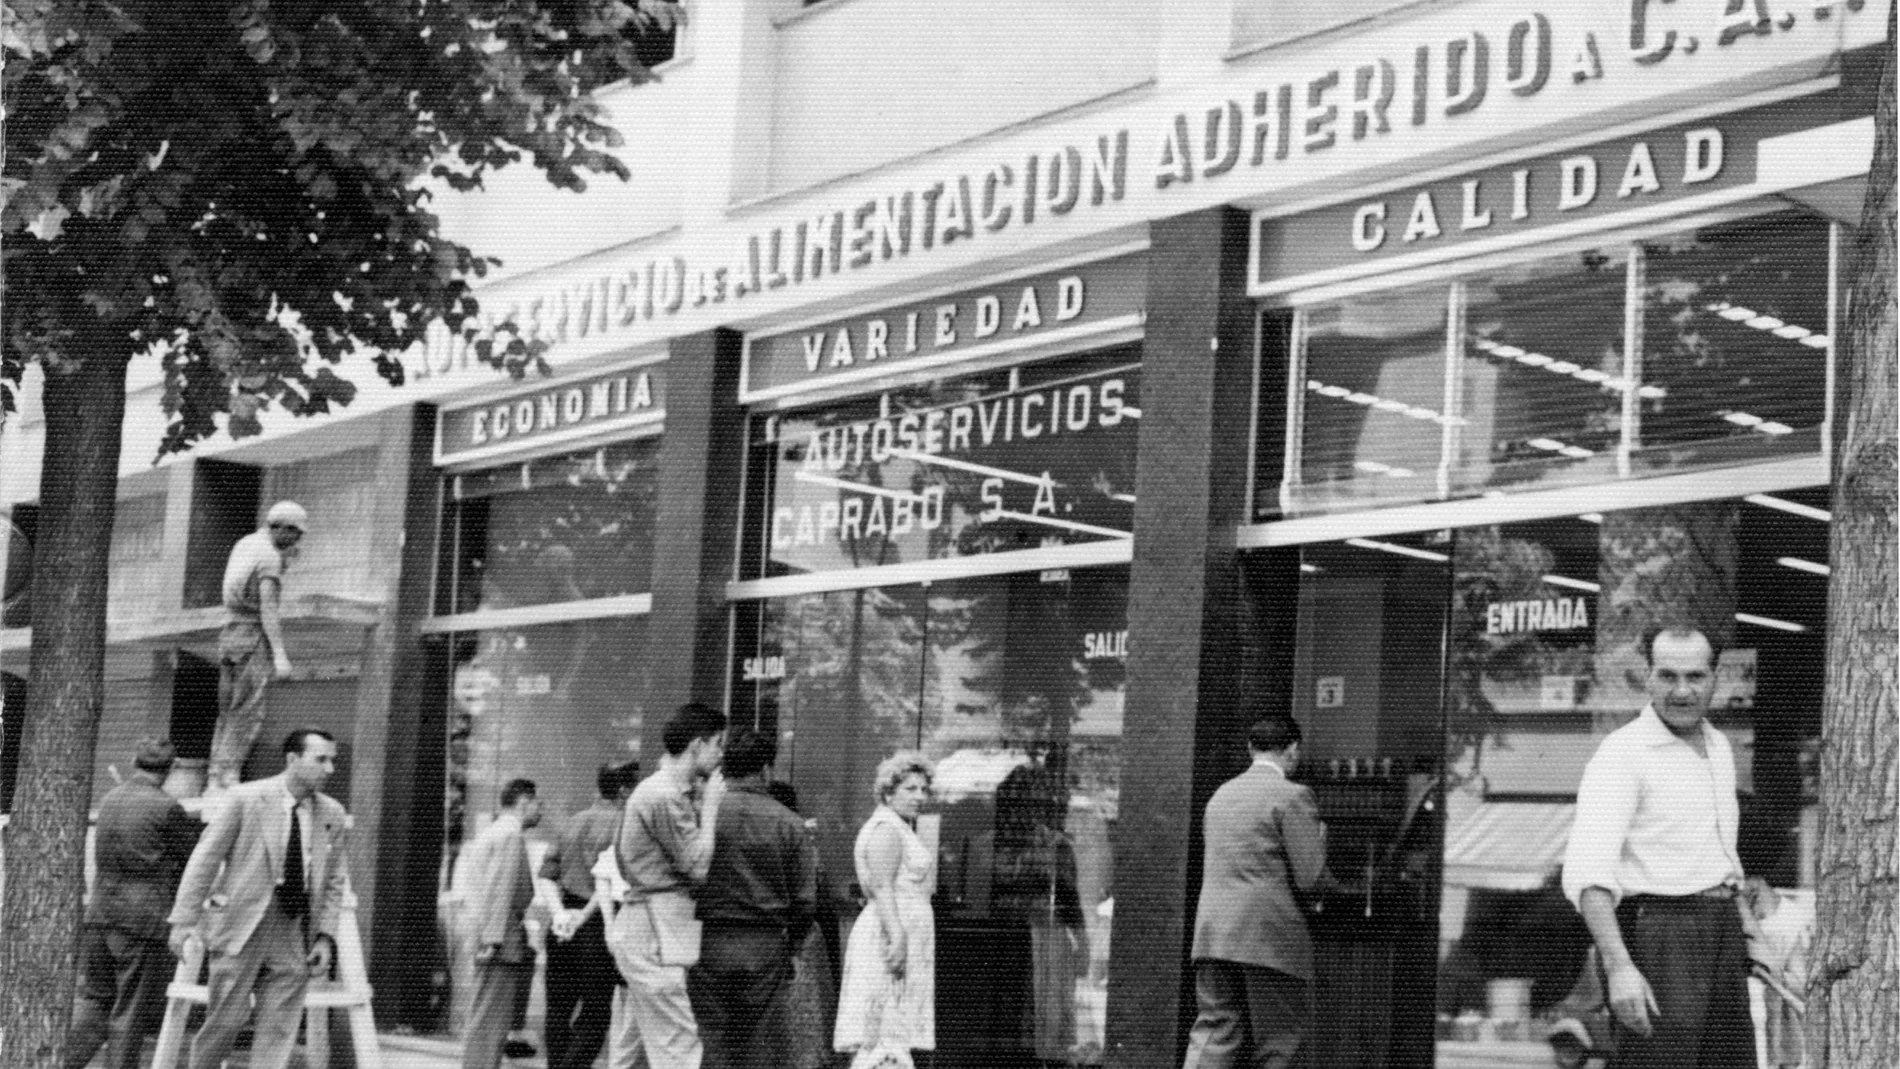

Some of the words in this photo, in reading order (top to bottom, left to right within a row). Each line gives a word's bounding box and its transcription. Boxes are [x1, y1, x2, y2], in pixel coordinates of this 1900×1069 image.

[734, 127, 1129, 298] ALIMENTACION
[1153, 9, 1551, 189] ADHERIDO
[1569, 28, 1603, 84] A
[1350, 127, 1726, 253] CALIDAD
[802, 275, 1086, 373] VARIEDAD
[471, 372, 653, 445] ECONOMIA
[803, 379, 1126, 473] AUTOSERVICIOS
[771, 484, 944, 551] CAPRABO
[1486, 597, 1588, 634] ENTRADA
[742, 655, 786, 681] SALIDA
